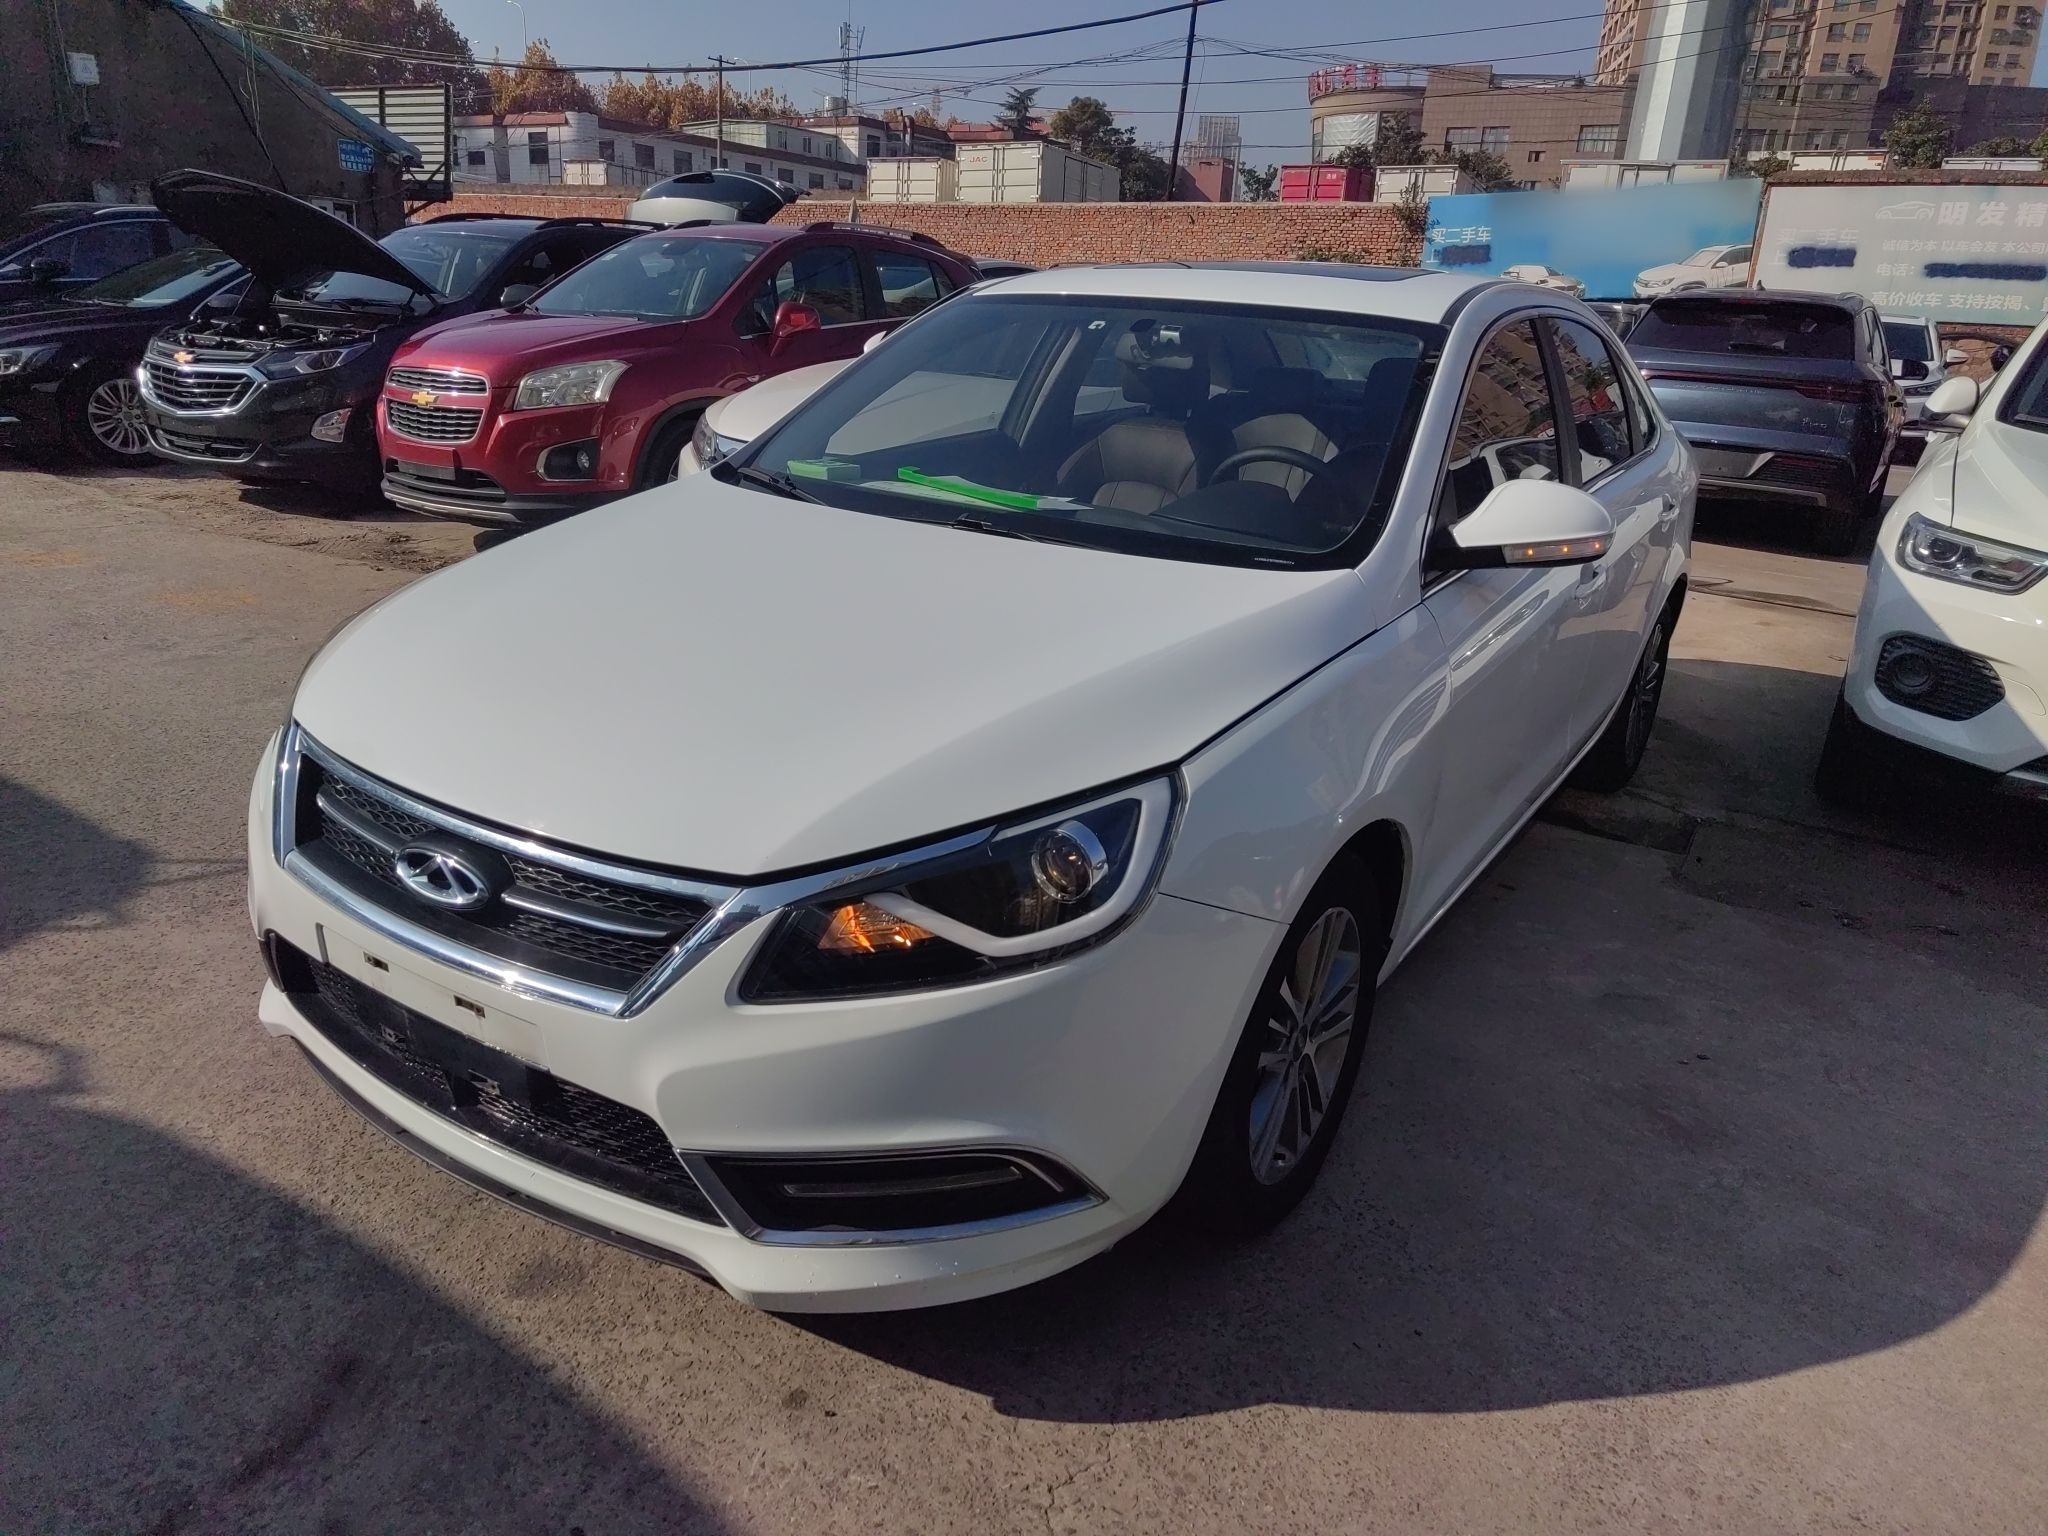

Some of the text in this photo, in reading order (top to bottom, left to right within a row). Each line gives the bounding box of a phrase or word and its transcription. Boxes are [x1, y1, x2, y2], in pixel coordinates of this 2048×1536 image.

[1432, 226, 1492, 244] 买二手车
[1776, 228, 1859, 246] 买二手车
[2001, 241, 2048, 255] 本公司
[1871, 291, 1943, 308] 高价收车
